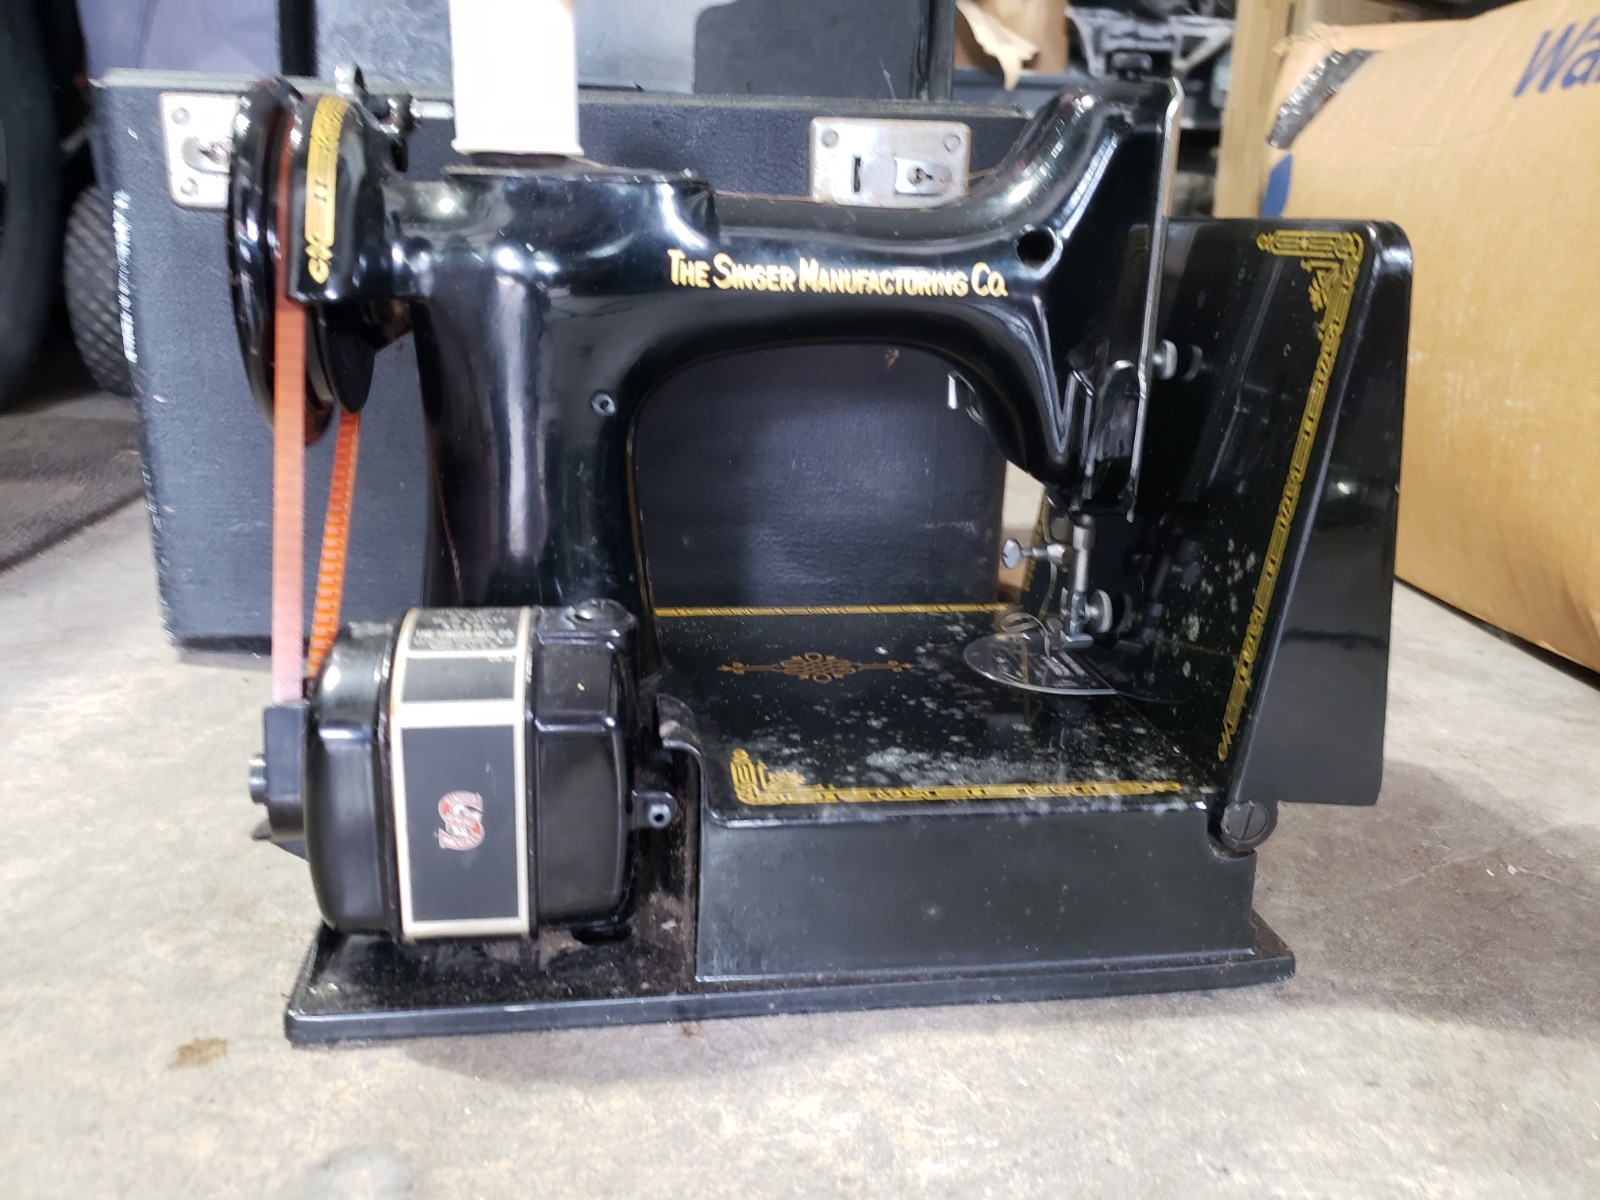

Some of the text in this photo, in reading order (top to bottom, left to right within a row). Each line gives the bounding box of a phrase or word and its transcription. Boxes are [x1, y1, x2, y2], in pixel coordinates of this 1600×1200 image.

[1512, 15, 1600, 99] Wa
[667, 248, 710, 289] THE
[712, 252, 797, 293] SINGER
[799, 256, 969, 298] MANUFACTURING
